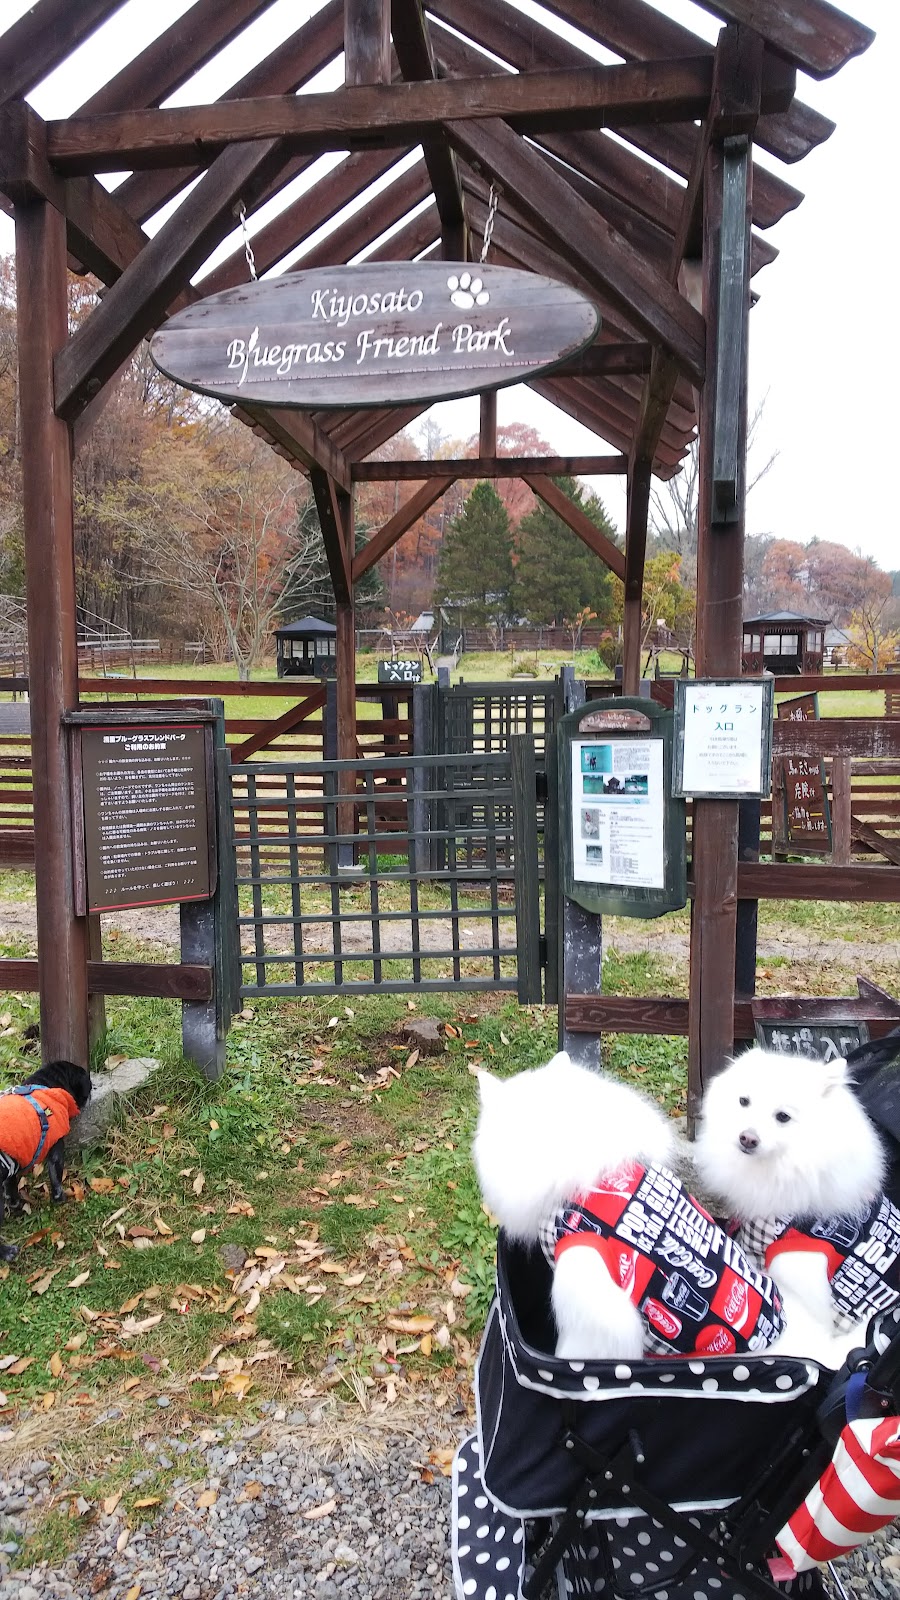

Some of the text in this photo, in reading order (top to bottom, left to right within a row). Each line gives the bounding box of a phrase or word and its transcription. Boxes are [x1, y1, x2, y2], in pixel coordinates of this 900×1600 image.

[310, 287, 424, 328] Kiyosato
[226, 318, 515, 388] Bluegrass Friend Park
[693, 704, 757, 714] ドッグラン
[714, 721, 734, 731] 入口
[615, 1201, 650, 1245] POP
[854, 1235, 897, 1275] POP
[834, 1261, 873, 1298] GLUG
